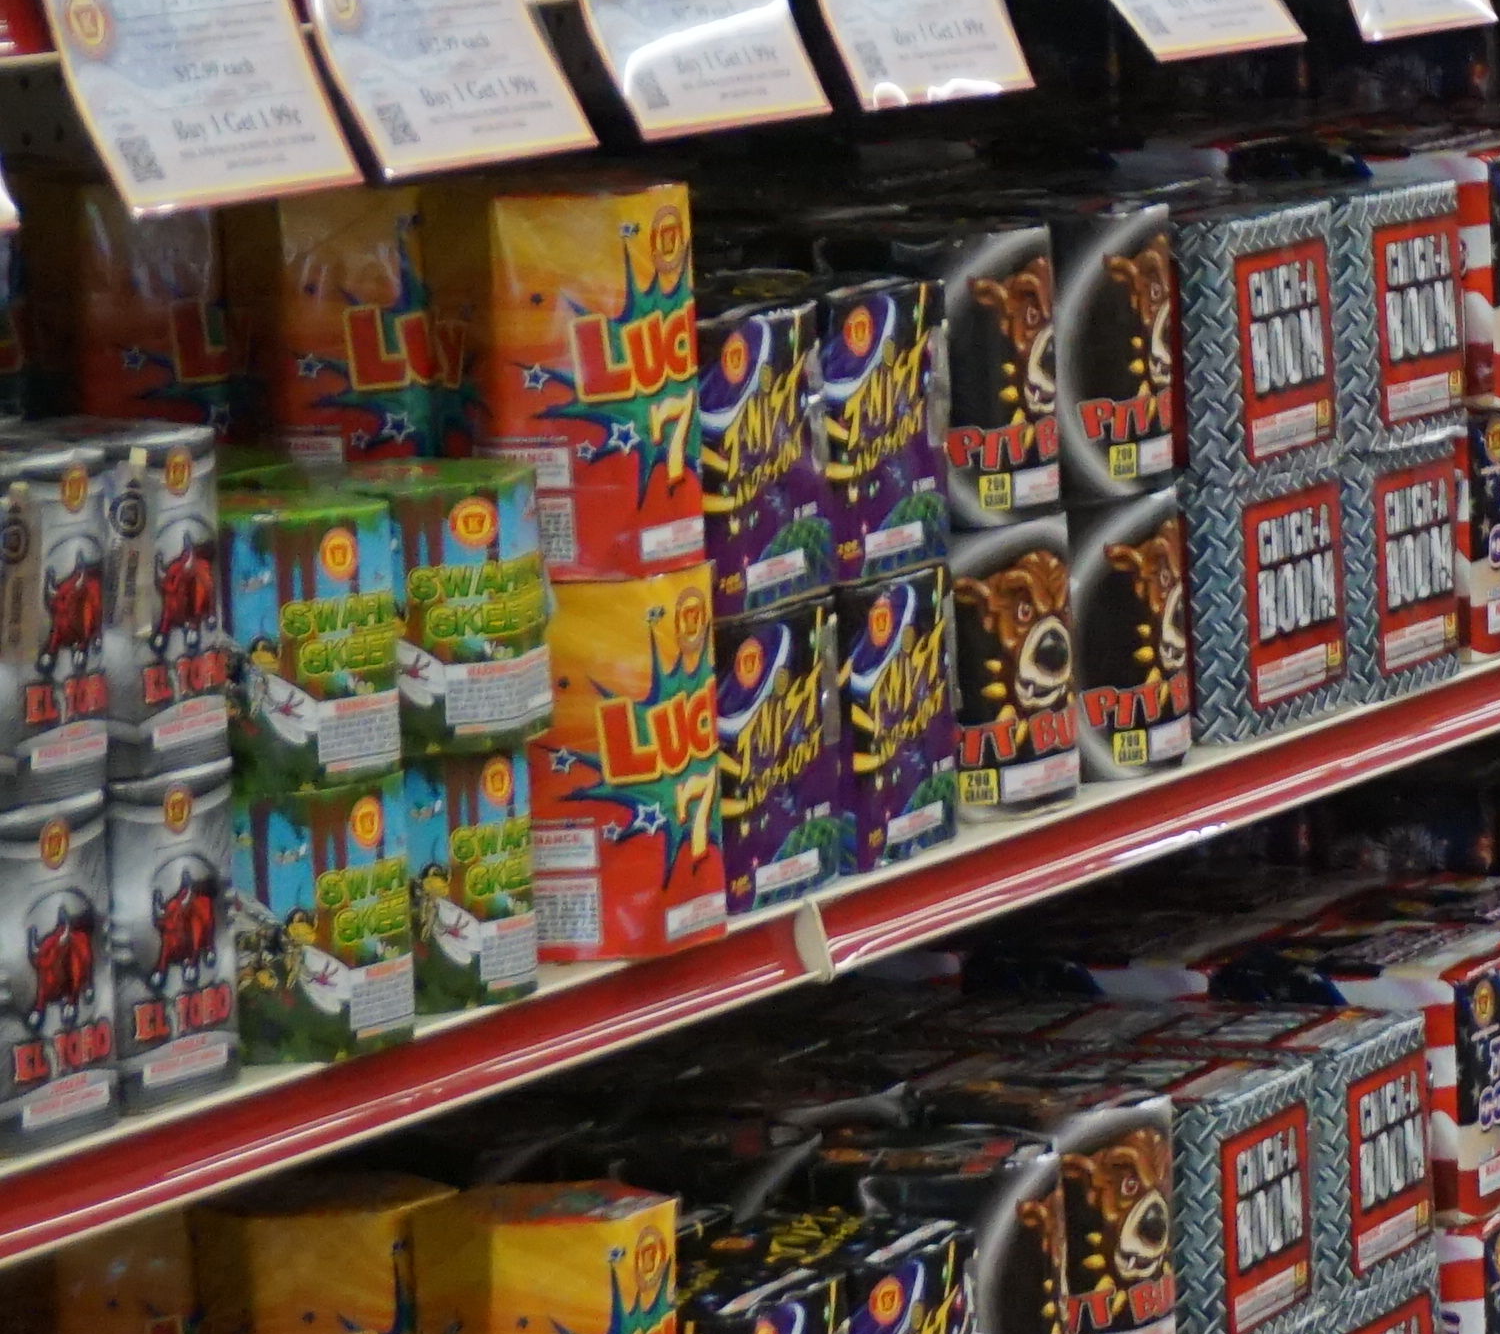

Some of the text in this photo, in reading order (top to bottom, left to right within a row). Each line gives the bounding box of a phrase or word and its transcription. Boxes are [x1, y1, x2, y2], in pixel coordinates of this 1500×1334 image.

[845, 332, 927, 453] TWIST
[648, 388, 693, 485] 7
[1082, 679, 1162, 729] PIT
[133, 982, 232, 1040] EL TORO
[13, 1019, 112, 1084] EL TORO
